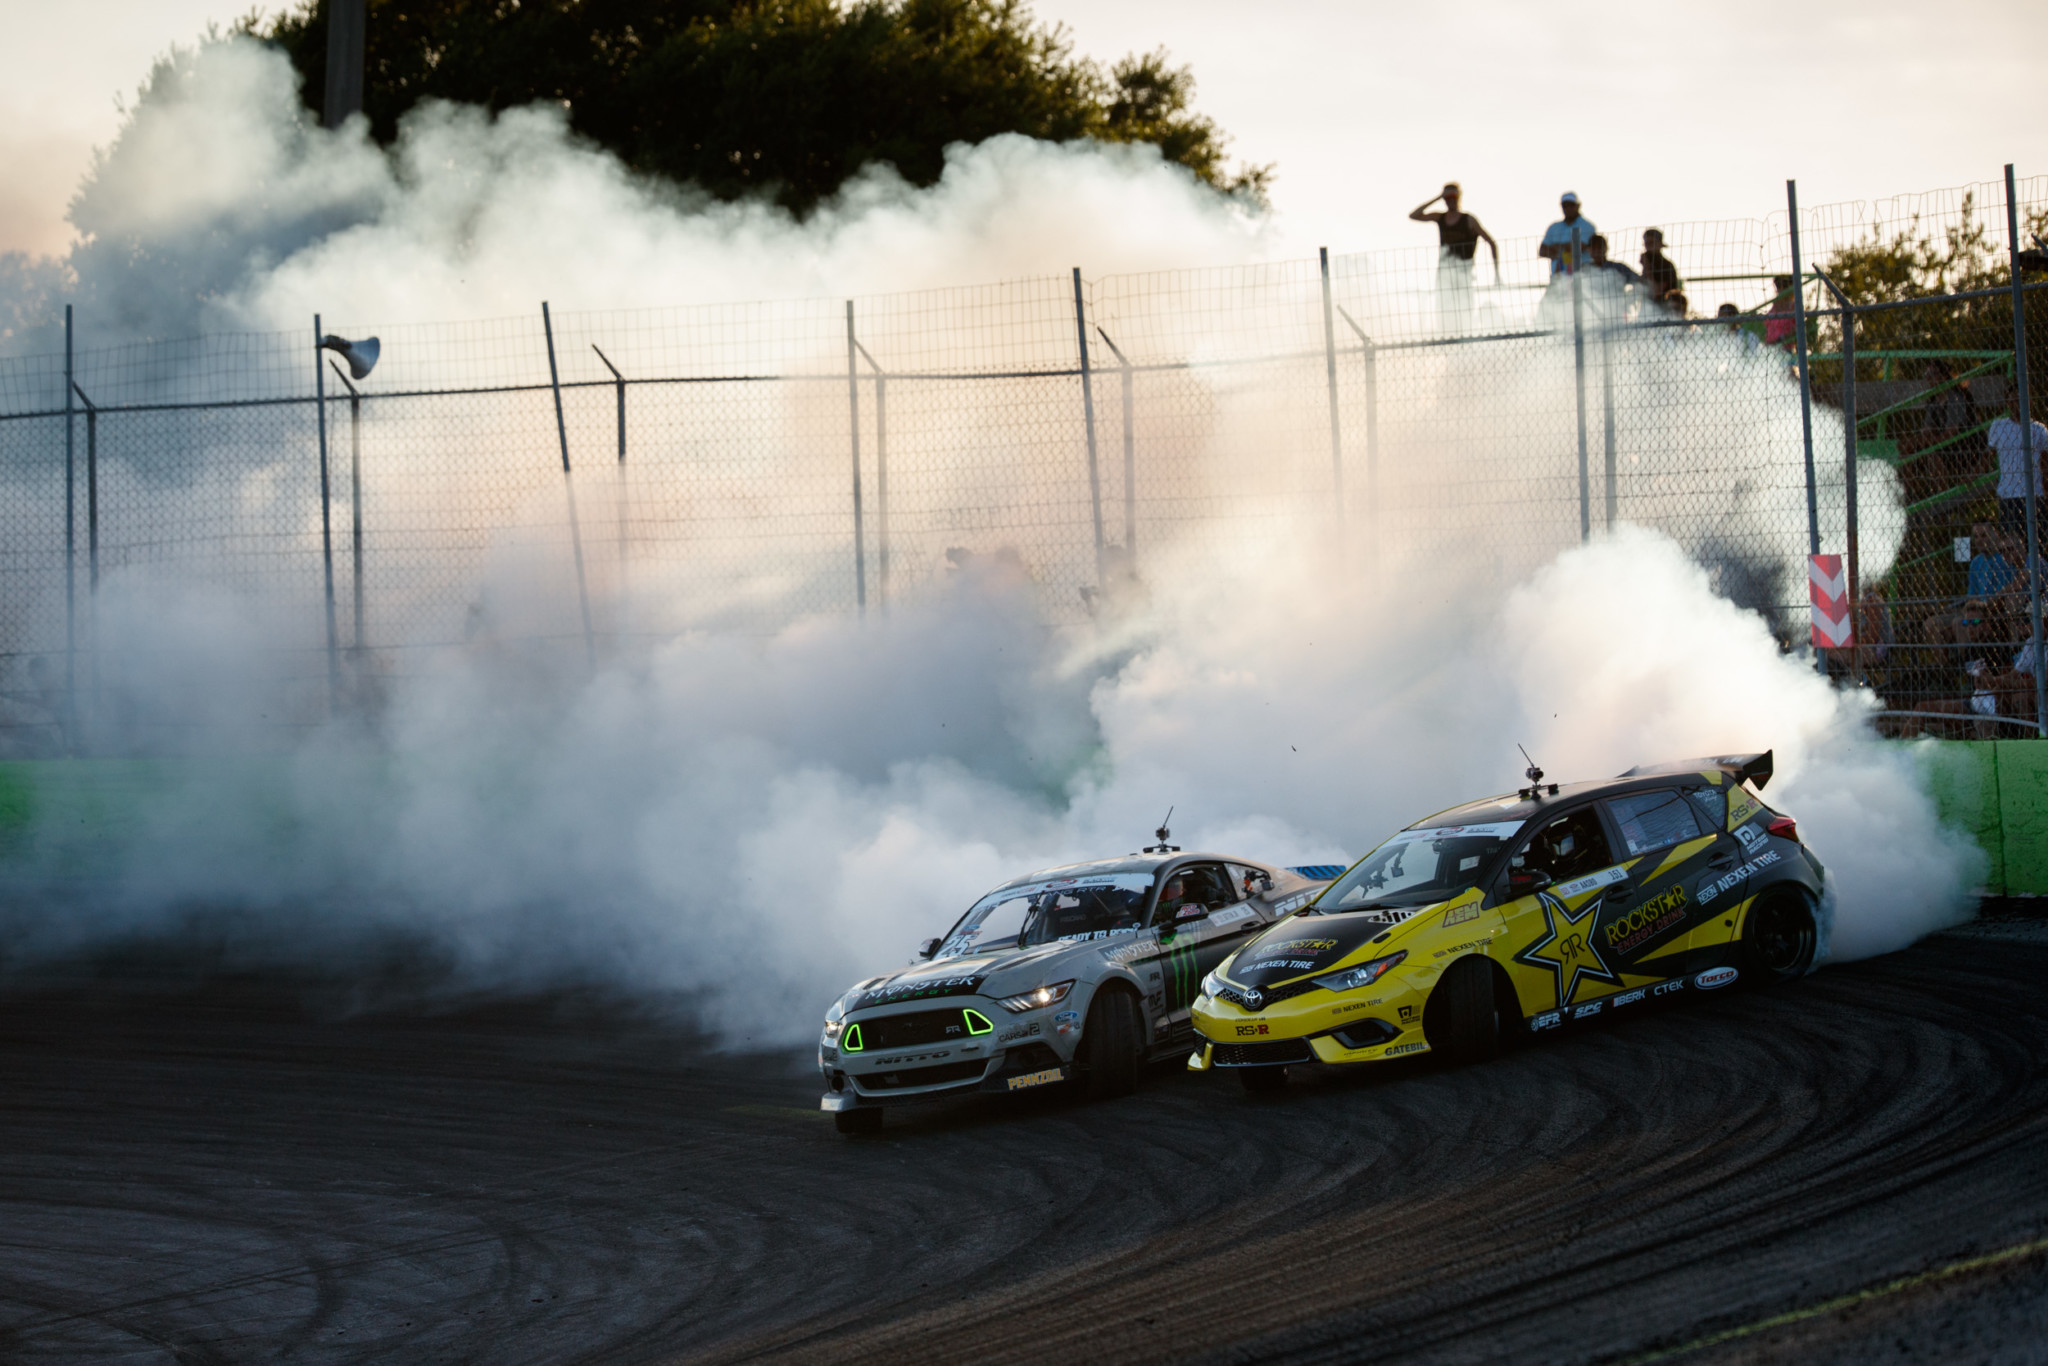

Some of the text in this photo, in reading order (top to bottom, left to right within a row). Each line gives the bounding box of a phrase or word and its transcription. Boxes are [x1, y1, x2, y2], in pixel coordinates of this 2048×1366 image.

[1608, 869, 1623, 881] 151
[1717, 850, 1781, 892] NEXEN TIRE
[1274, 886, 1328, 917] NIT
[1442, 901, 1479, 928] AEM
[1448, 943, 1477, 954] NEXEN
[1475, 937, 1493, 946] TIRE
[1254, 960, 1289, 970] NEXEN
[1289, 960, 1315, 970] TIRE
[1701, 970, 1734, 984] Torco
[1653, 980, 1684, 996] CTEK
[1343, 1003, 1366, 1012] NEXEN
[1367, 998, 1383, 1006] TIRE
[1385, 1042, 1425, 1056] GATEBIL
[875, 1050, 950, 1065] NITTO
[1007, 1067, 1065, 1090] PENNZOIL
